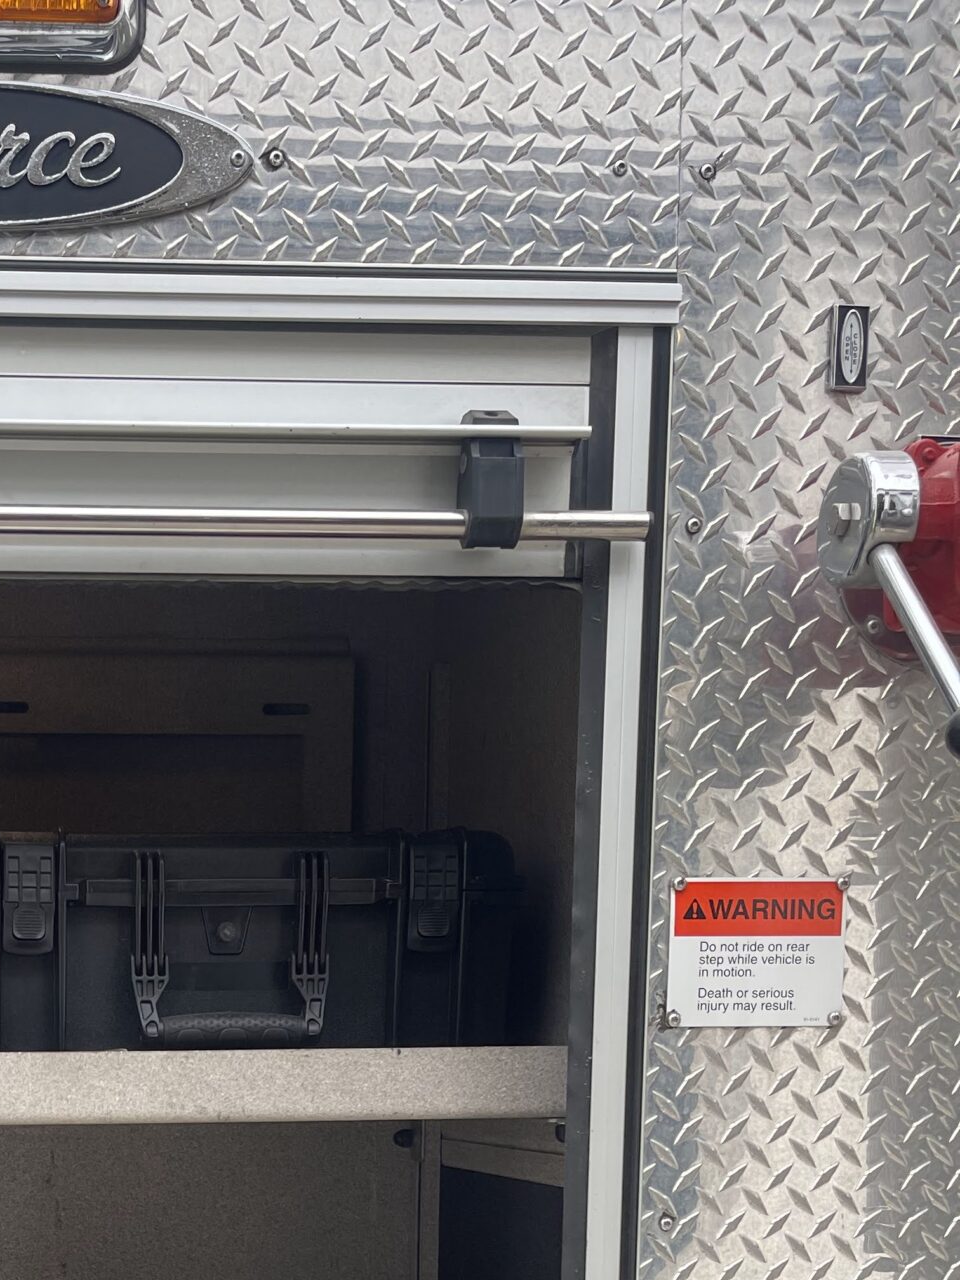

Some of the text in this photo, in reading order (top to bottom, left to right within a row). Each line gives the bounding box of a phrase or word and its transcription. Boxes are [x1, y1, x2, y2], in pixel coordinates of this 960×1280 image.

[709, 898, 836, 920] WARNING
[699, 941, 810, 952] Do not ride on rear
[699, 954, 816, 968] step while vehicle is
[698, 967, 756, 978] in motion.
[697, 987, 794, 999] Death or serious
[697, 1000, 796, 1014] injury may result.
